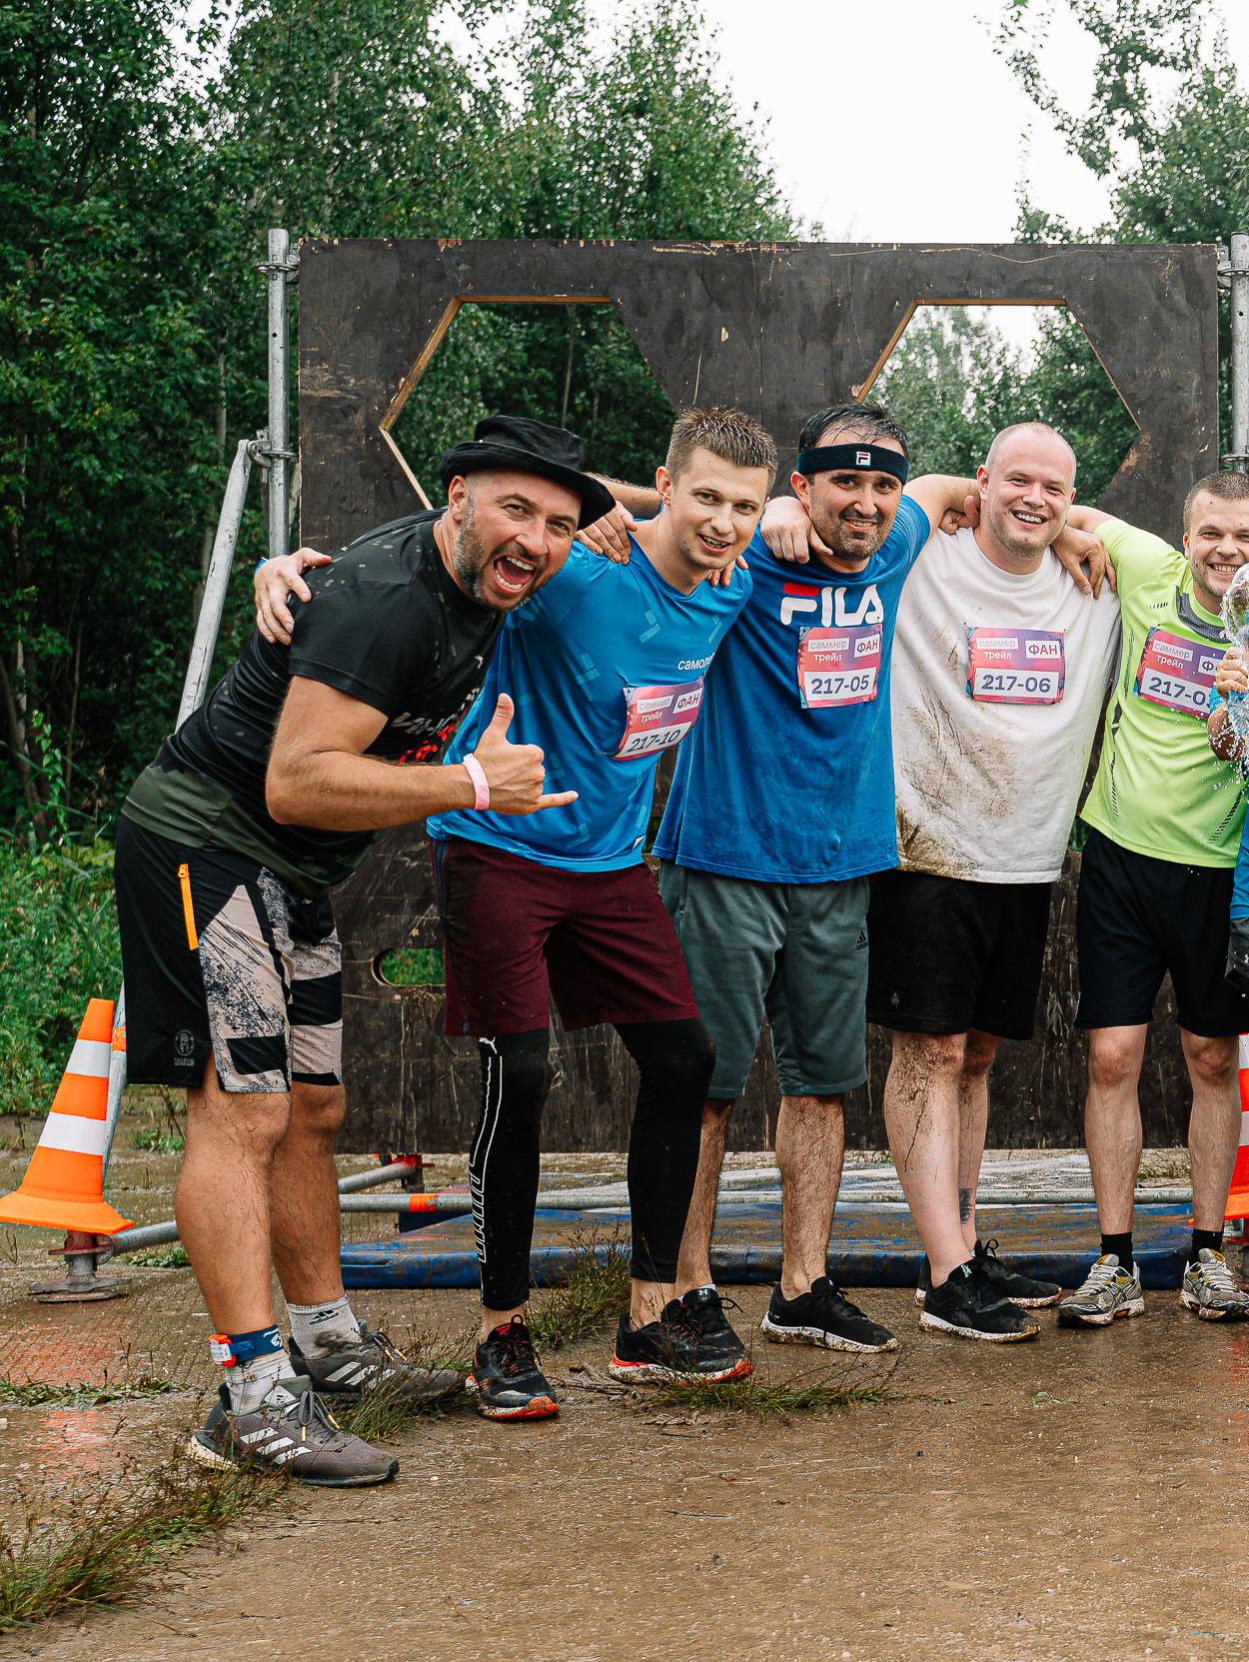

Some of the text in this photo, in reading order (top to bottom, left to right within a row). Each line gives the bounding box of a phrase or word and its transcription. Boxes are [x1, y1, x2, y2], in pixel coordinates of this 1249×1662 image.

[780, 582, 884, 628] FILA
[856, 638, 878, 654] ФАН
[1028, 643, 1058, 656] ФАН
[814, 653, 842, 664] трейл
[984, 651, 1012, 661] трейл
[1156, 653, 1184, 670] трейл
[811, 674, 870, 695] 217-05
[981, 674, 1051, 693] 217-06
[1149, 676, 1211, 708] 217-0
[677, 693, 700, 709] ФАН
[627, 728, 682, 753] 217-10
